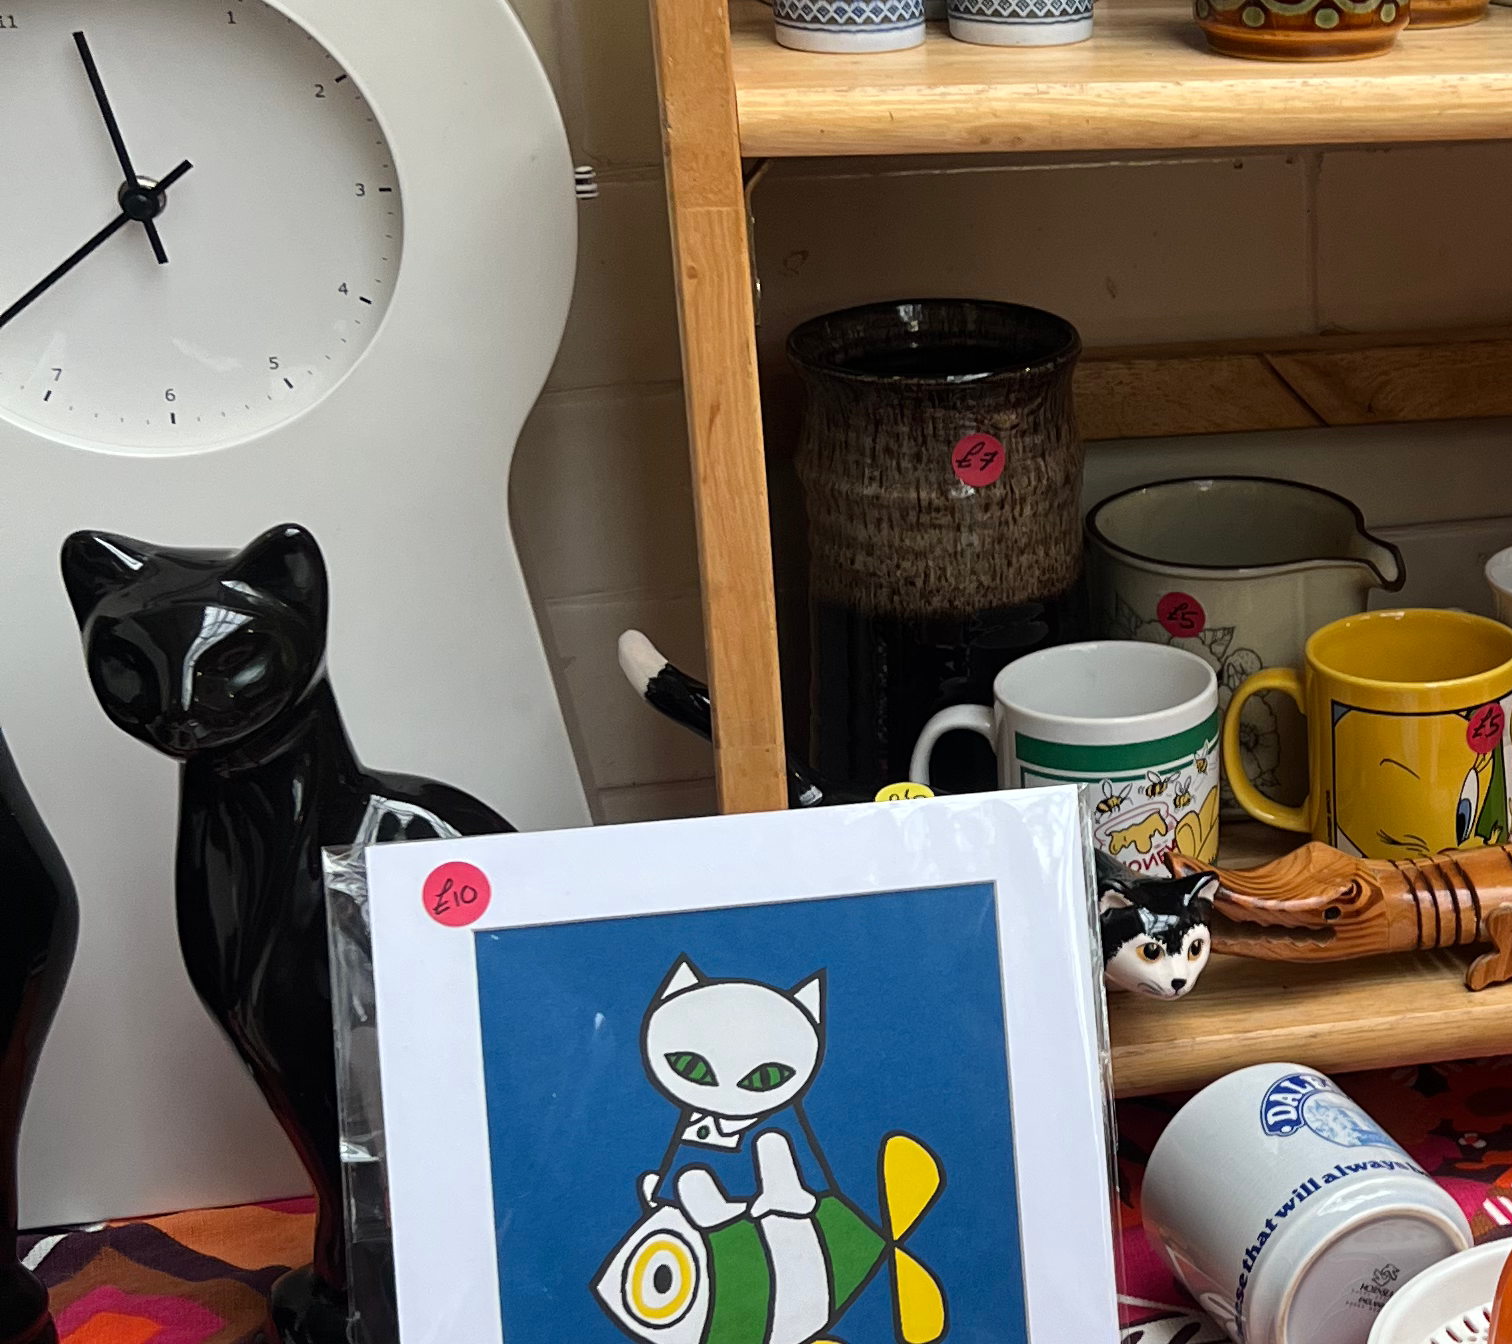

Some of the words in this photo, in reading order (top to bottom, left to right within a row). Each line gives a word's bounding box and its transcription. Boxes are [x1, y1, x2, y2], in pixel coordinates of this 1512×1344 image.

[227, 11, 237, 24] 1
[314, 84, 325, 98] 2
[355, 183, 365, 197] 3
[338, 282, 348, 295] 4
[268, 357, 279, 370] 5
[51, 368, 62, 381] 7
[165, 388, 176, 402] 6
[955, 442, 998, 471] £7
[1167, 602, 1198, 629] £5
[1472, 707, 1502, 738] £5
[433, 878, 478, 915] £10
[1242, 1217, 1278, 1273] that
[1274, 1177, 1322, 1218] will
